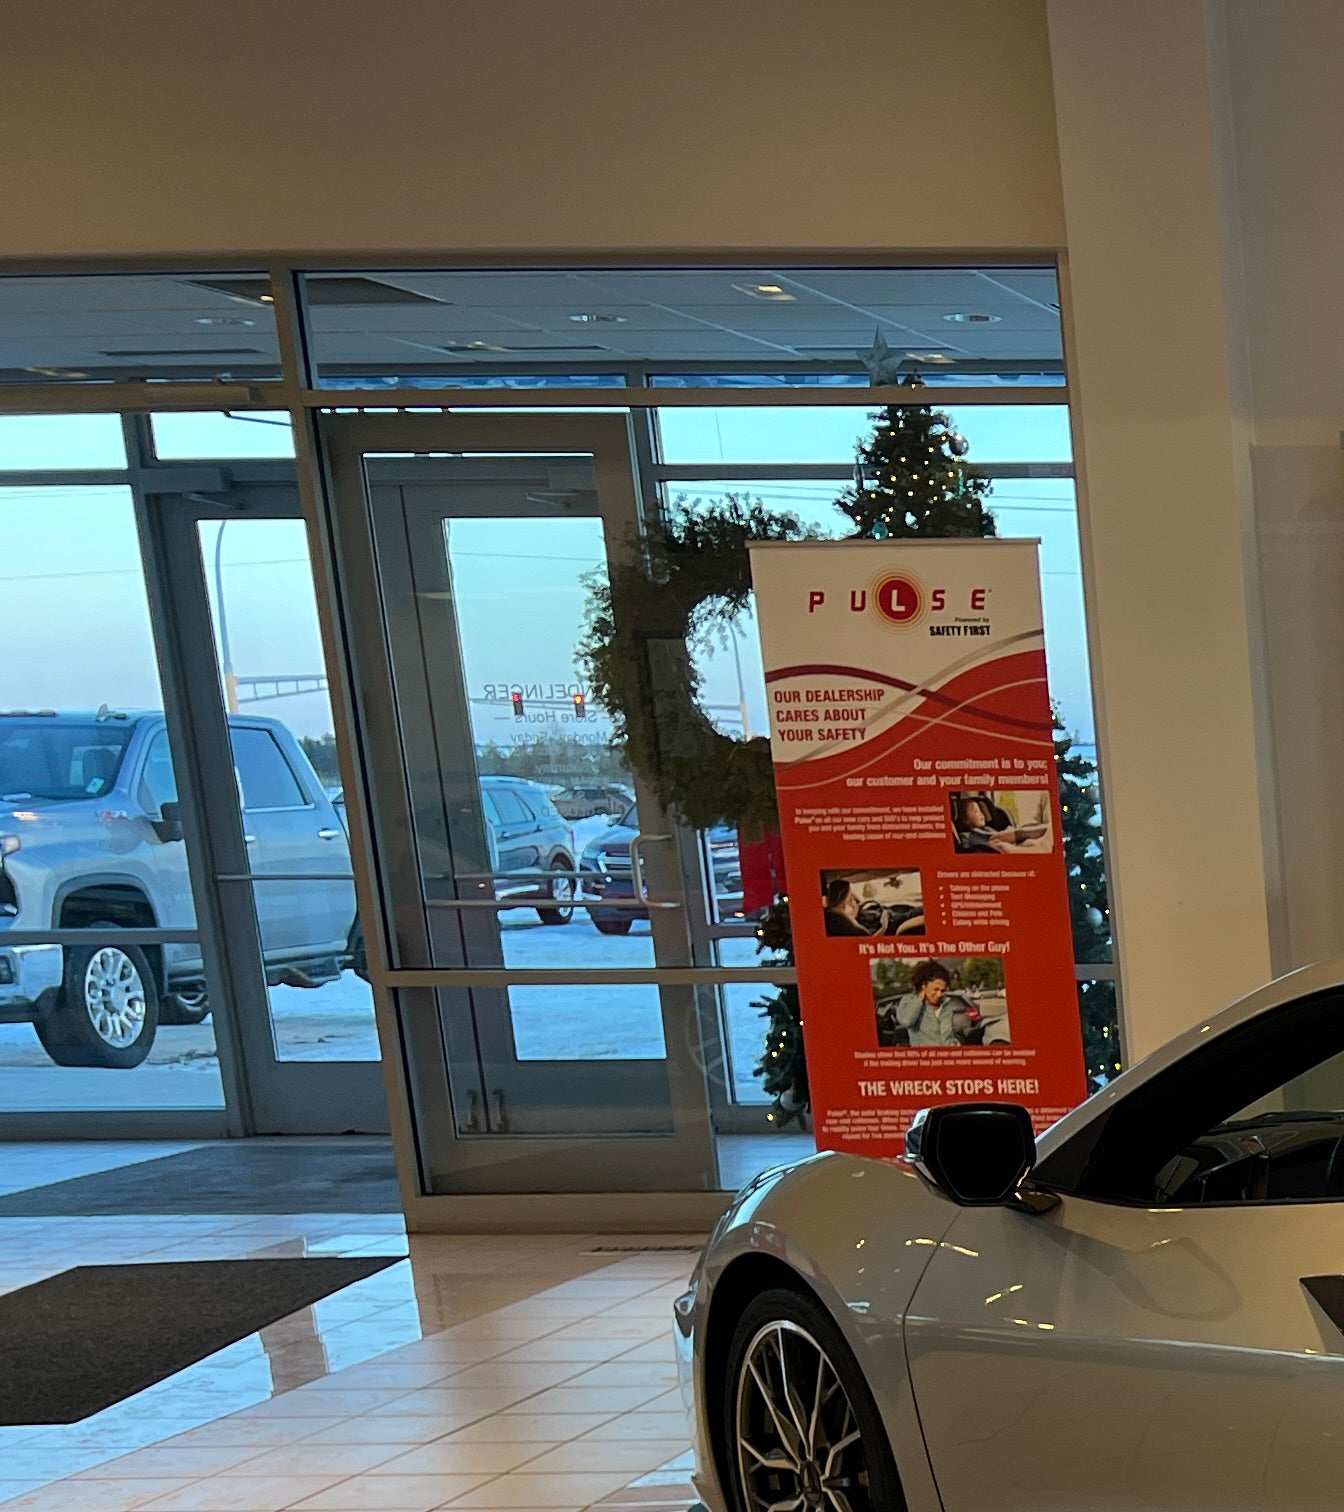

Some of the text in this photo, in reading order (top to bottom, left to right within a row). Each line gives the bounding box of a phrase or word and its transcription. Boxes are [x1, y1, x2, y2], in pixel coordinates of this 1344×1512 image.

[809, 587, 985, 612] PULSE
[929, 625, 961, 636] SAFETY
[774, 689, 885, 703] OUR DEALERSHIP
[776, 708, 866, 723] CARES ABOUT
[778, 727, 866, 742] YOUR SAFETY
[913, 758, 932, 771] Our
[935, 757, 999, 771] commitment
[1001, 757, 1011, 770] is
[1013, 758, 1025, 769] to
[846, 772, 1049, 788] our customer and your family members!
[858, 940, 1010, 955] It's Not You. It's The Other Guy!
[858, 1078, 1040, 1096] THE WRECK STOPS HERE!
